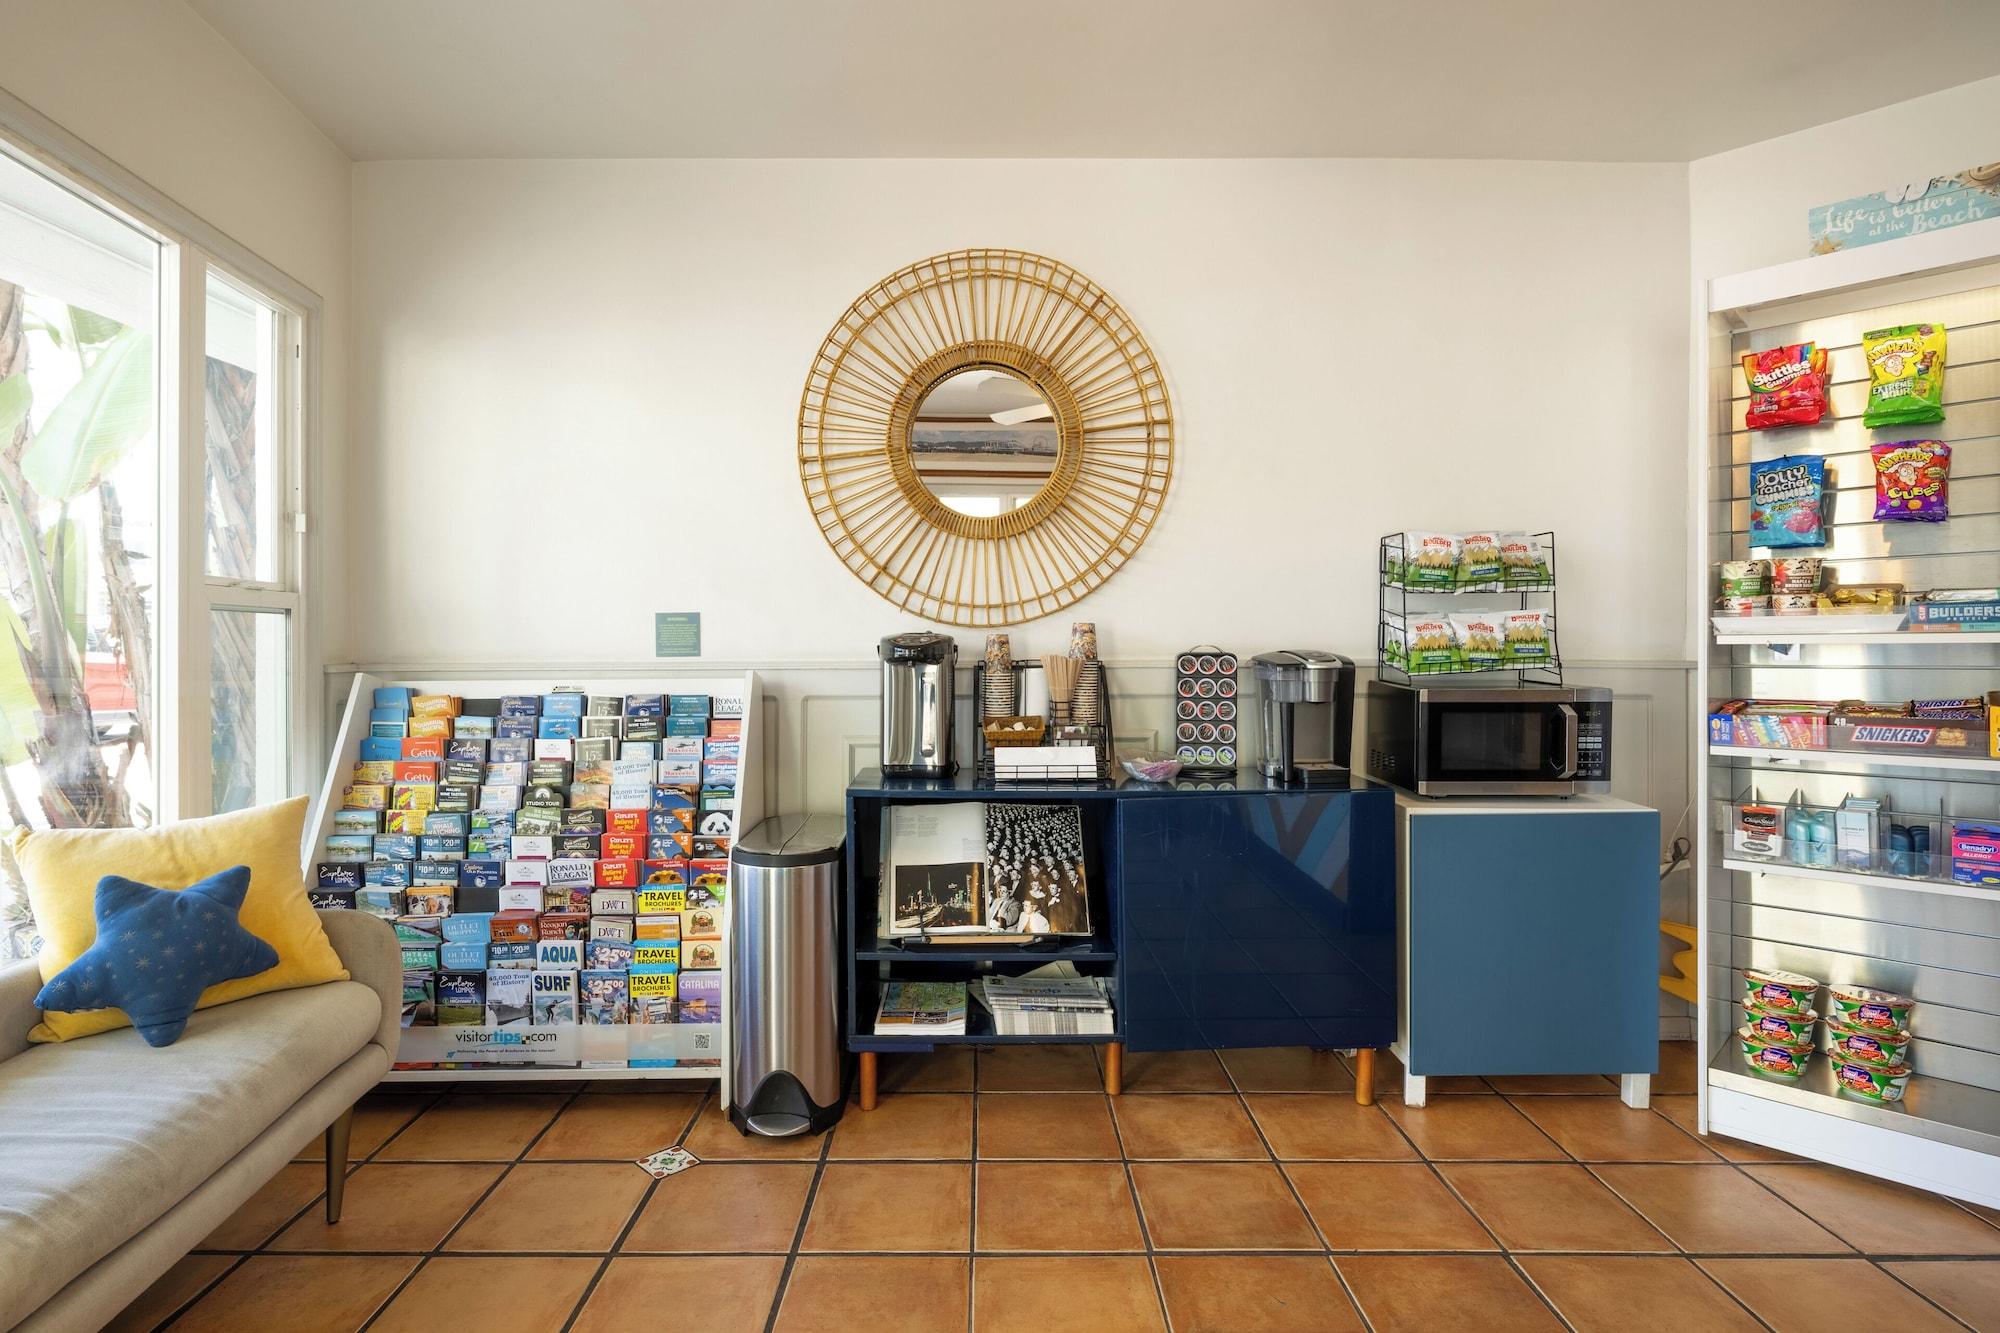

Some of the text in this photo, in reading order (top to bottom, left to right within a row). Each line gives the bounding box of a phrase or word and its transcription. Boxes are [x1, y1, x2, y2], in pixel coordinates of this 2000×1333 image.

[1822, 206, 1869, 234] Life
[1869, 211, 1886, 225] is
[1869, 199, 1988, 236] at the Beach
[1868, 341, 1924, 364] WARHEADS
[1753, 360, 1811, 388] Skittles
[1877, 450, 1933, 472] WARHEADS
[1757, 466, 1806, 488] JOLLY
[1759, 477, 1811, 495] rancher
[1888, 482, 1940, 499] CUBES
[1756, 485, 1815, 505] GUMMIES
[1424, 537, 1452, 548] BOULDER
[1929, 606, 2000, 618] BUILDERS
[1834, 717, 1846, 726] 48
[1855, 727, 1931, 744] SNICKERS
[411, 748, 438, 758] Getty
[450, 742, 482, 756] Explore
[405, 772, 432, 783] Getty
[1744, 817, 1775, 826] ChapStick
[1961, 843, 1995, 853] Benadryl
[320, 866, 355, 883] Explore
[549, 863, 587, 872] RONALD
[551, 871, 588, 880] REAGAN
[311, 894, 346, 908] Explore
[644, 892, 682, 901] TRAVEL
[601, 900, 627, 910] DWT
[598, 927, 624, 937] DWT
[541, 946, 578, 963] AQUA
[637, 949, 676, 958] TRAVEL
[440, 976, 475, 990] Explore
[534, 975, 571, 991] SURF
[631, 976, 671, 985] TRAVEL
[680, 979, 720, 989] CATALINA
[455, 1030, 557, 1045] visitortips.com
